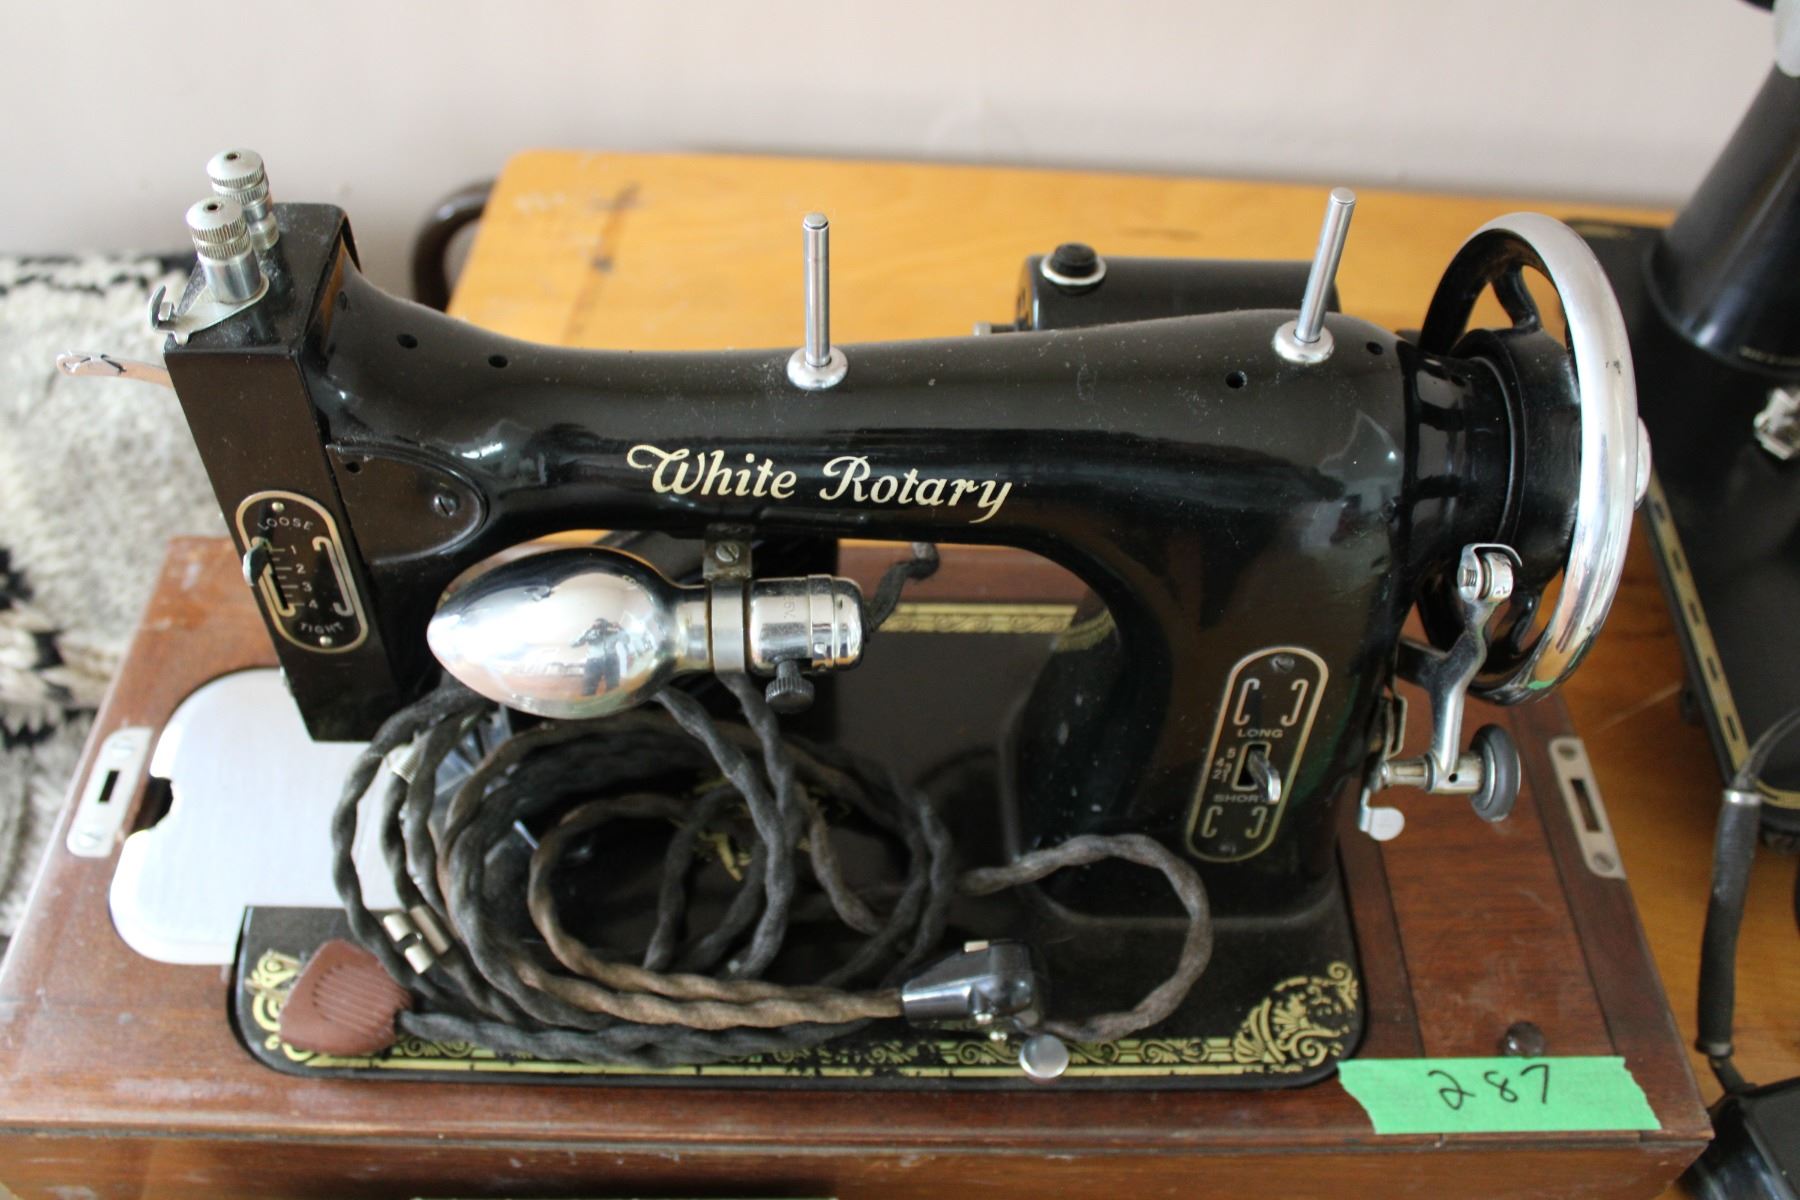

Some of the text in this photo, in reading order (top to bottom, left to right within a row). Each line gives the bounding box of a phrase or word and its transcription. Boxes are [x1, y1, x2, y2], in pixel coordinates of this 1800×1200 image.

[626, 444, 1013, 523] White Rotary
[257, 516, 314, 532] LOOSE
[290, 545, 297, 555] 1
[296, 563, 306, 574] 2
[302, 582, 312, 592] 3
[308, 599, 318, 609] 4
[300, 621, 344, 634] TIGHT
[1237, 728, 1284, 739] LONG
[1213, 793, 1266, 804] SHOR
[1427, 1064, 1550, 1110] 287
